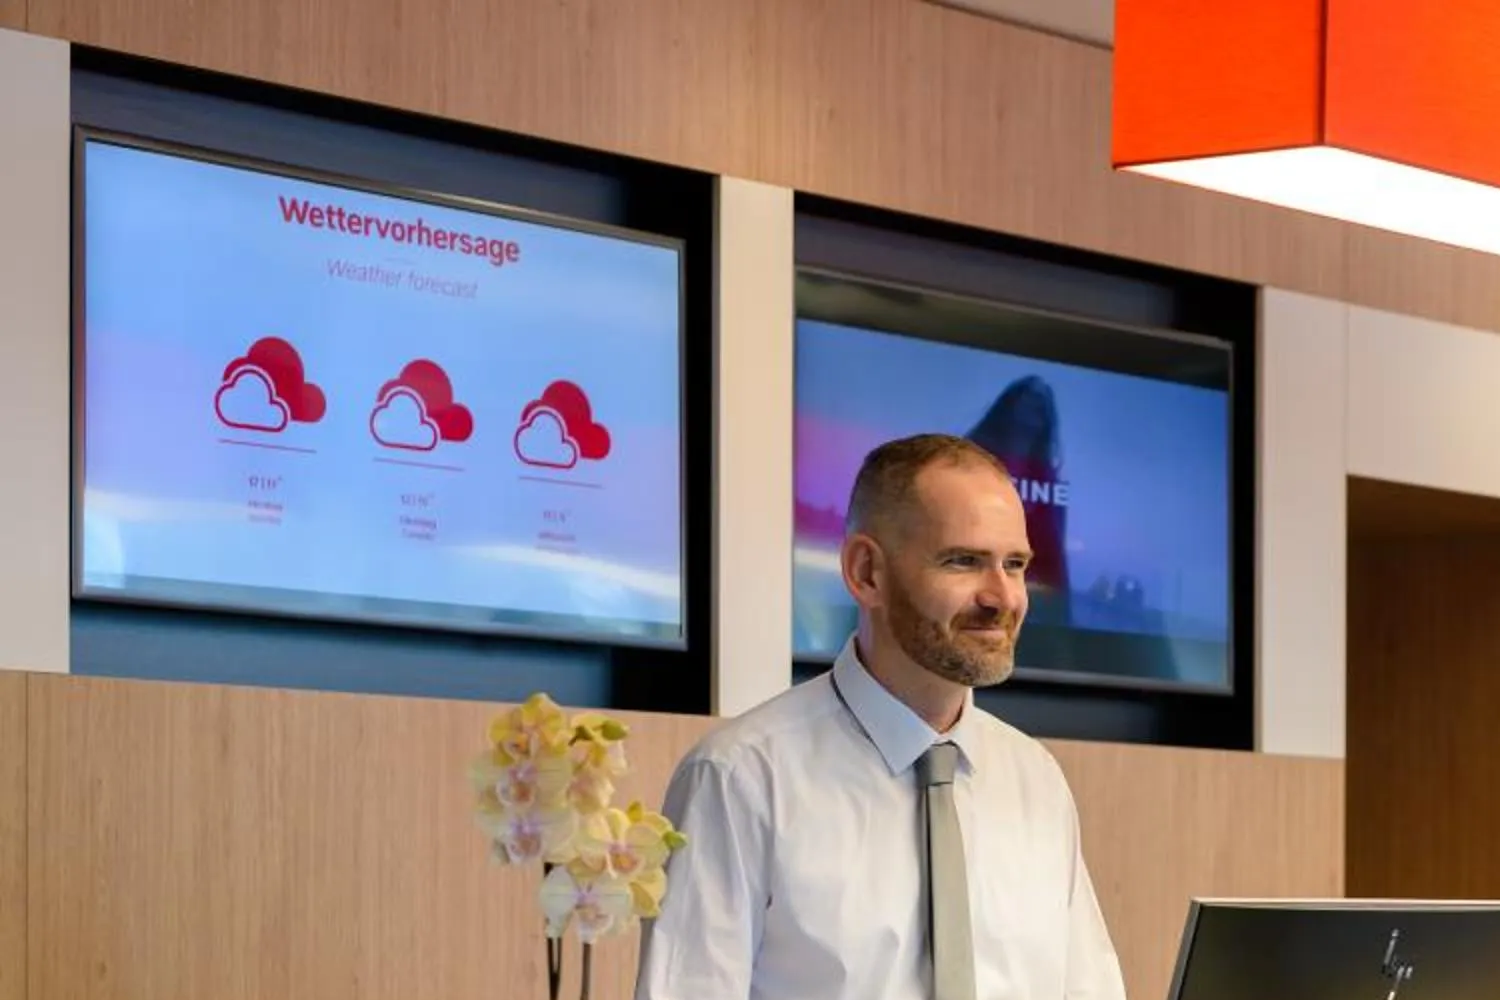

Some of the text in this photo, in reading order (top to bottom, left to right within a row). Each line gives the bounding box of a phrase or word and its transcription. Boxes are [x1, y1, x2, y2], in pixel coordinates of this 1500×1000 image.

[279, 195, 520, 266] Wettervorhersage
[326, 258, 479, 299] Weather forecast
[1011, 476, 1069, 507] INE
